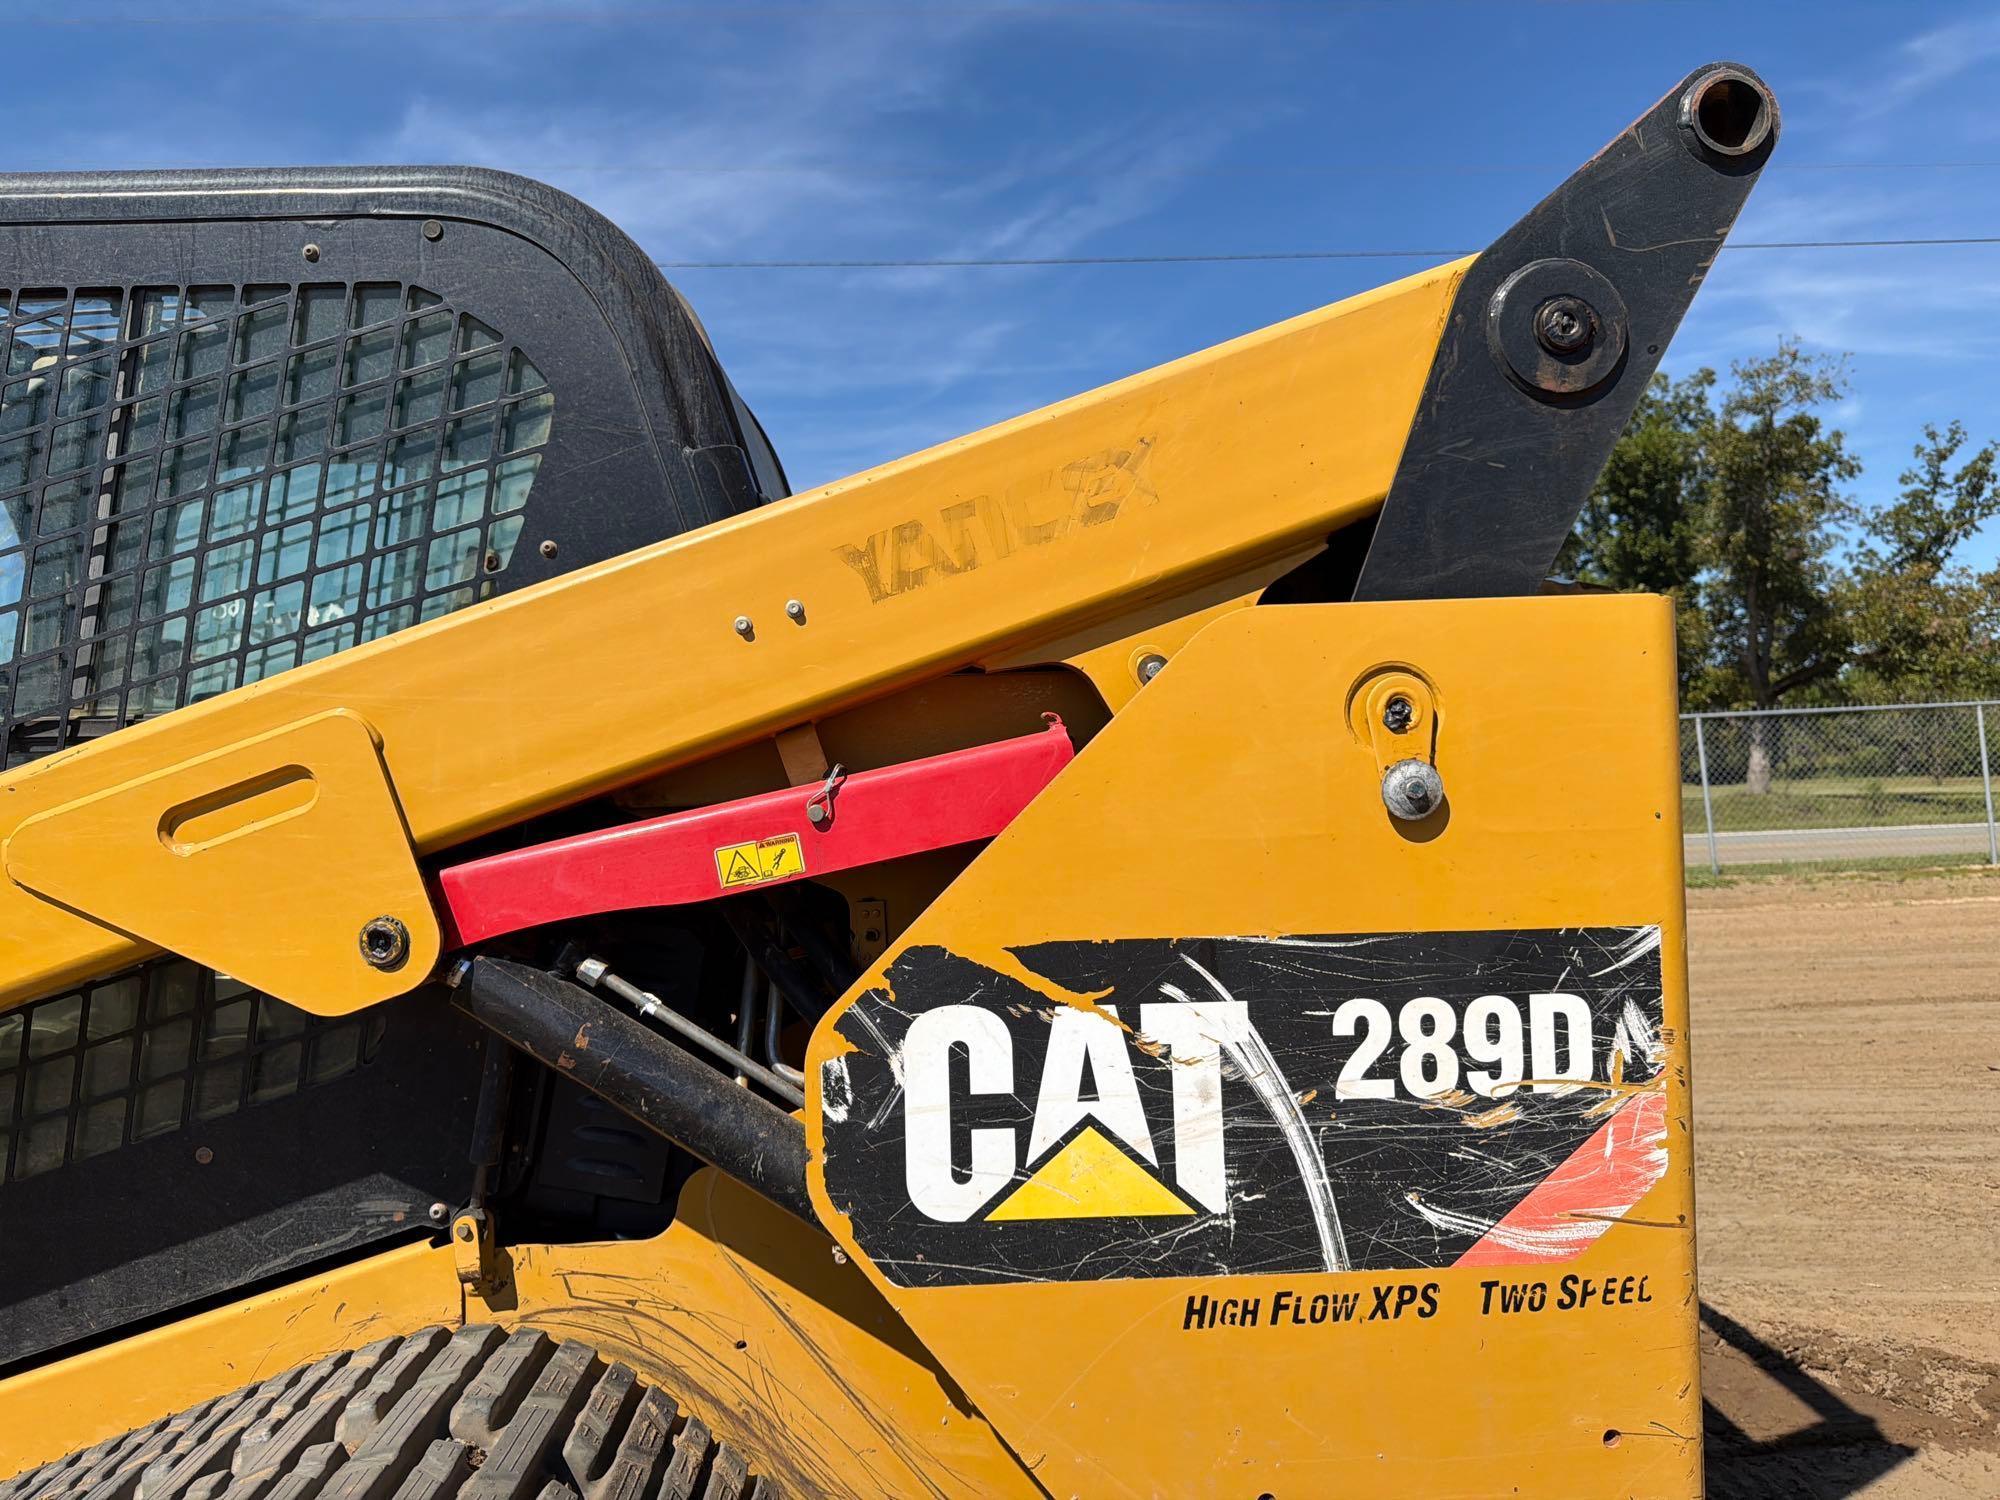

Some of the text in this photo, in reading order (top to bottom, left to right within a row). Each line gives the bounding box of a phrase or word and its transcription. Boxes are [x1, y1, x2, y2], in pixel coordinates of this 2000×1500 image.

[765, 836, 795, 847] WARNING
[1332, 993, 1594, 1101] 289D
[902, 1000, 1248, 1223] CAT
[1183, 1282, 1441, 1330] HIGH FLOW XPS
[1480, 1280, 1548, 1315] TWO
